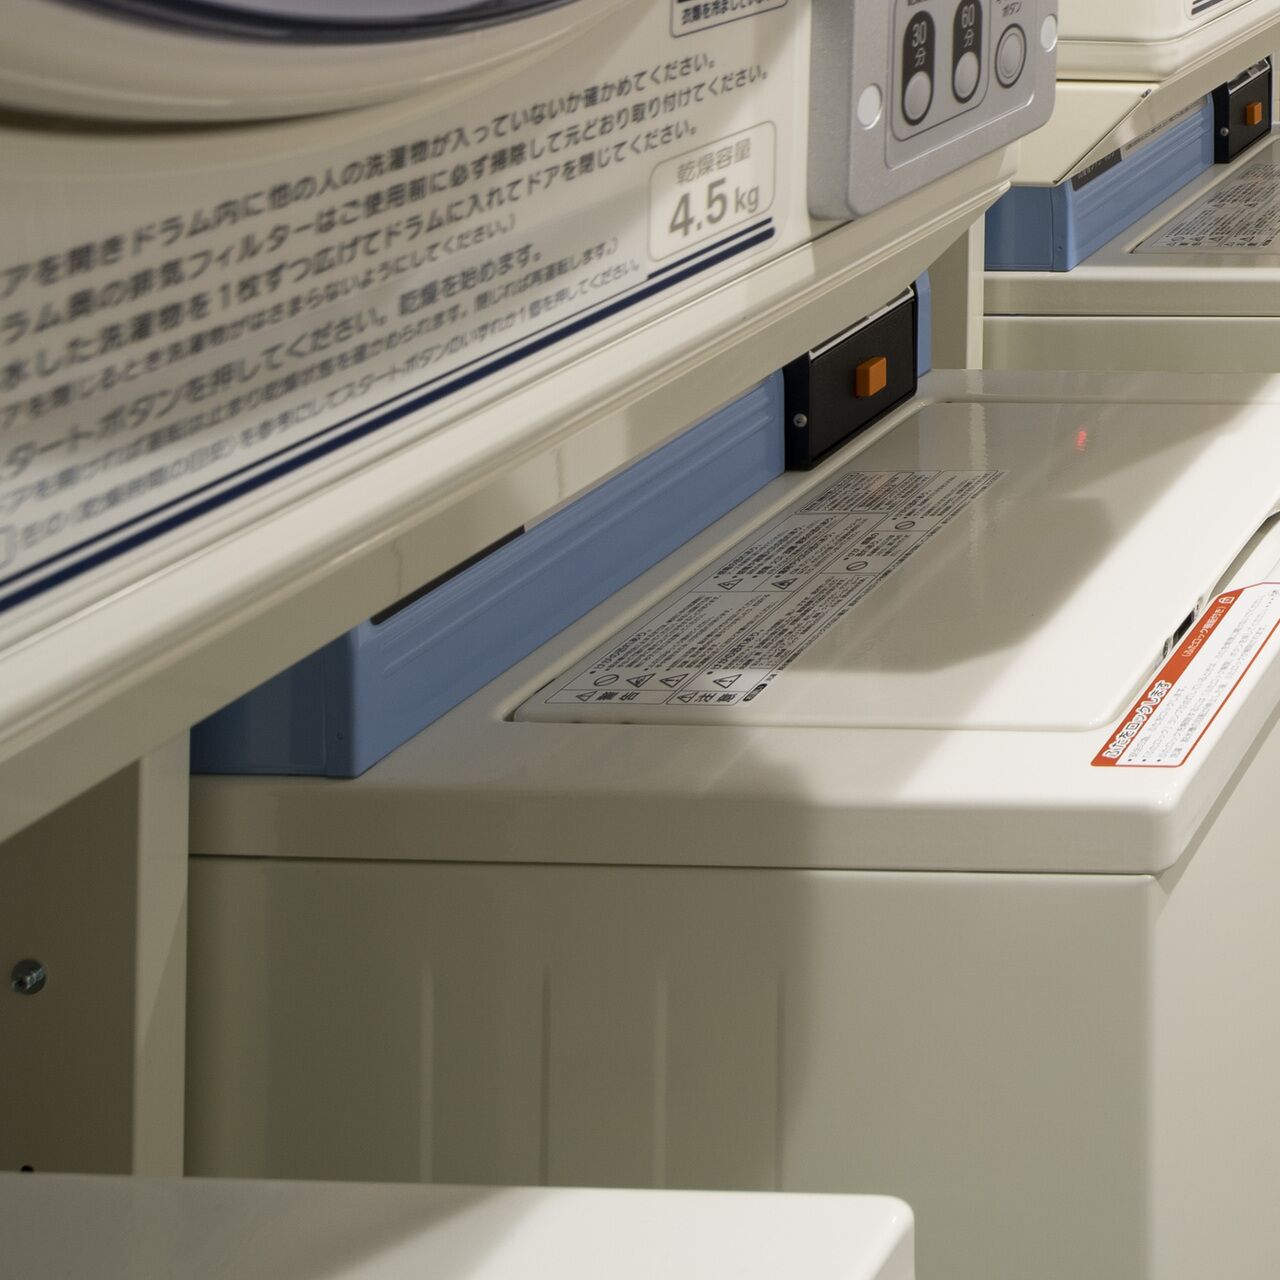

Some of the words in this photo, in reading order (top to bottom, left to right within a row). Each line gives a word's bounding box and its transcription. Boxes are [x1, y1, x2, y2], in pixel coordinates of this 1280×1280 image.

[961, 4, 976, 30] 60
[1002, 1, 1022, 17] ボタン
[912, 22, 927, 49] 30
[676, 138, 752, 186] 乾燥容量
[1103, 680, 1173, 759] ふたをロックします
